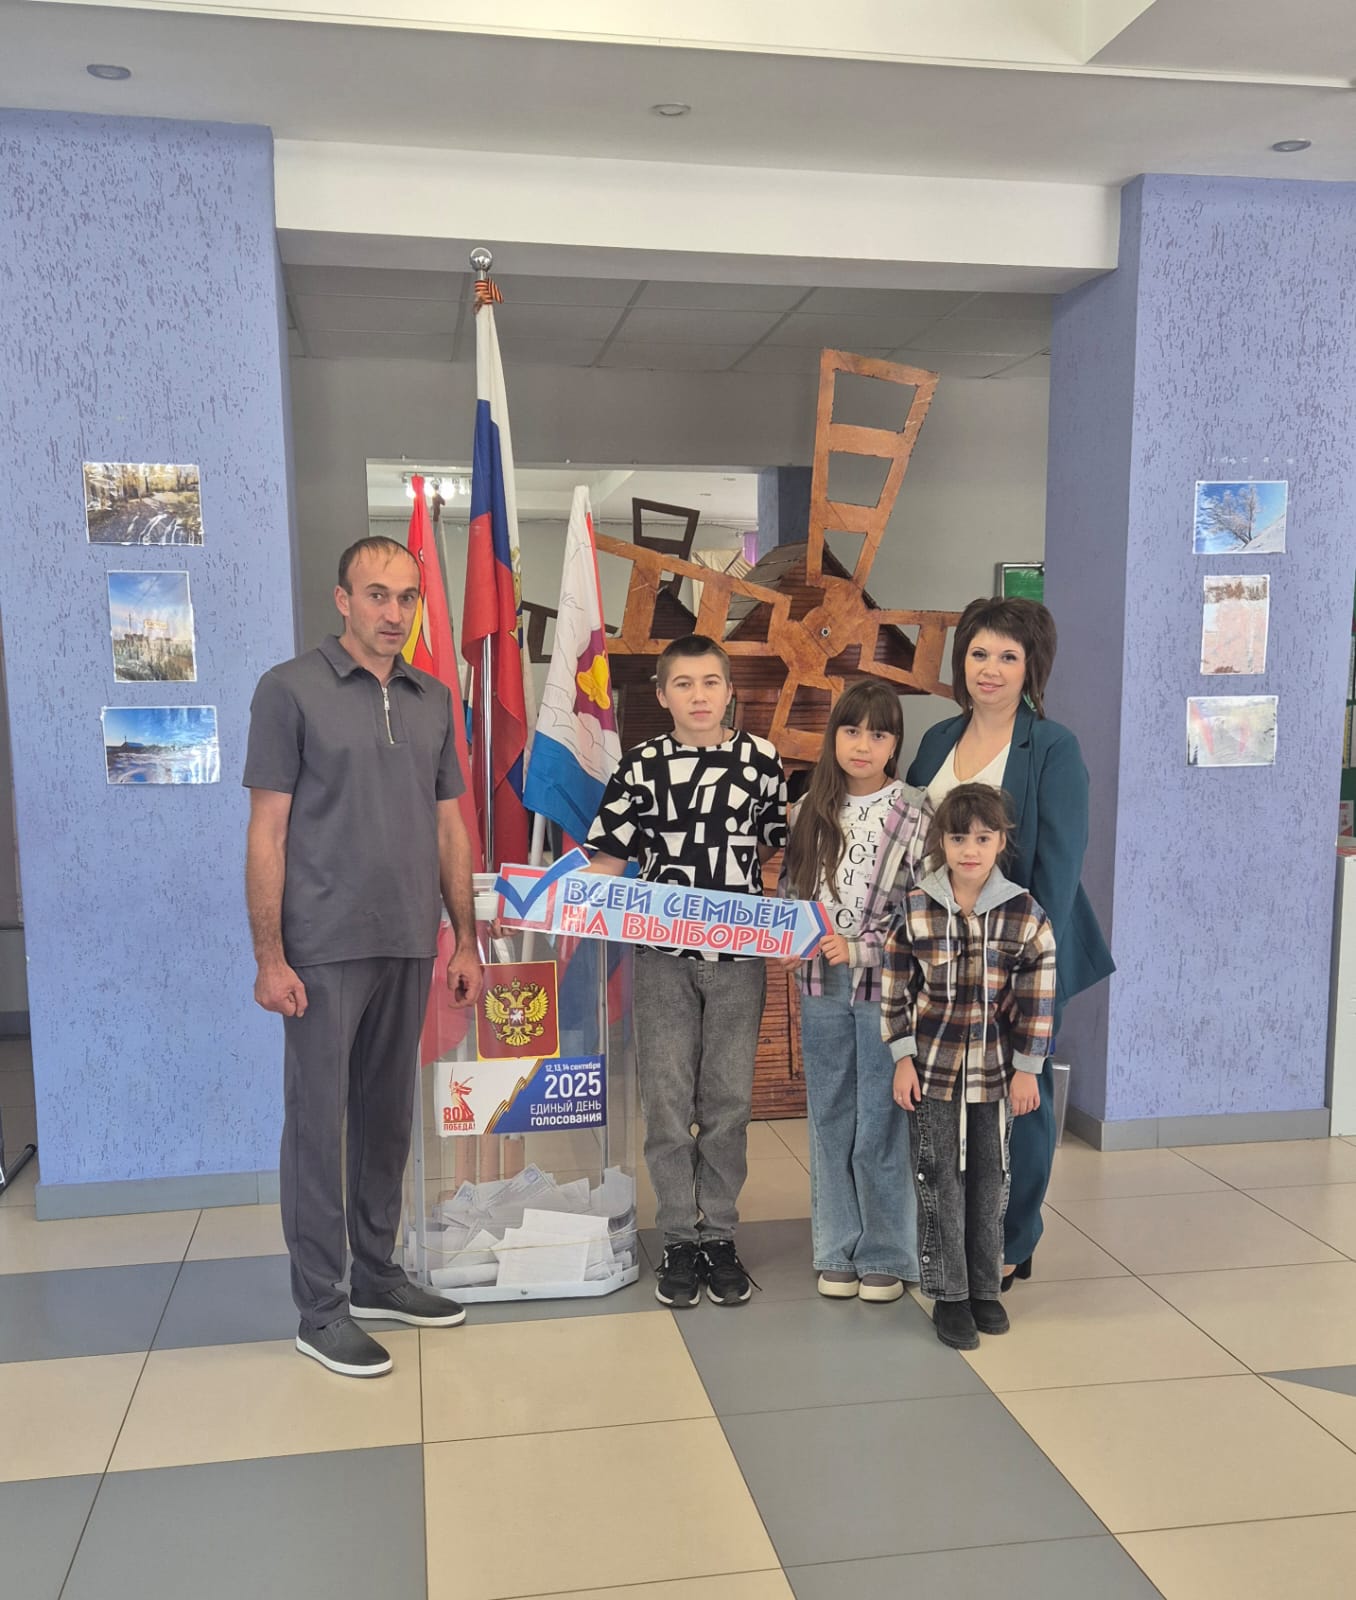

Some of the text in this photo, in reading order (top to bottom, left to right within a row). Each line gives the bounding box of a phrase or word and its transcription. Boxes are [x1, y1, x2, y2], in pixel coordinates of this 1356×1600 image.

[563, 877, 799, 931] ВСЕЙ СЕМЬЁЙ
[560, 905, 794, 956] НА ВЫБОРЫ
[570, 1061, 601, 1071] сентября
[544, 1071, 602, 1099] 2025
[443, 1107, 460, 1122] 80
[530, 1100, 602, 1116] ЕДИНЫЙ ДЕНЬ
[443, 1123, 475, 1131] ПОБЕДА!
[531, 1112, 602, 1127] голосования
